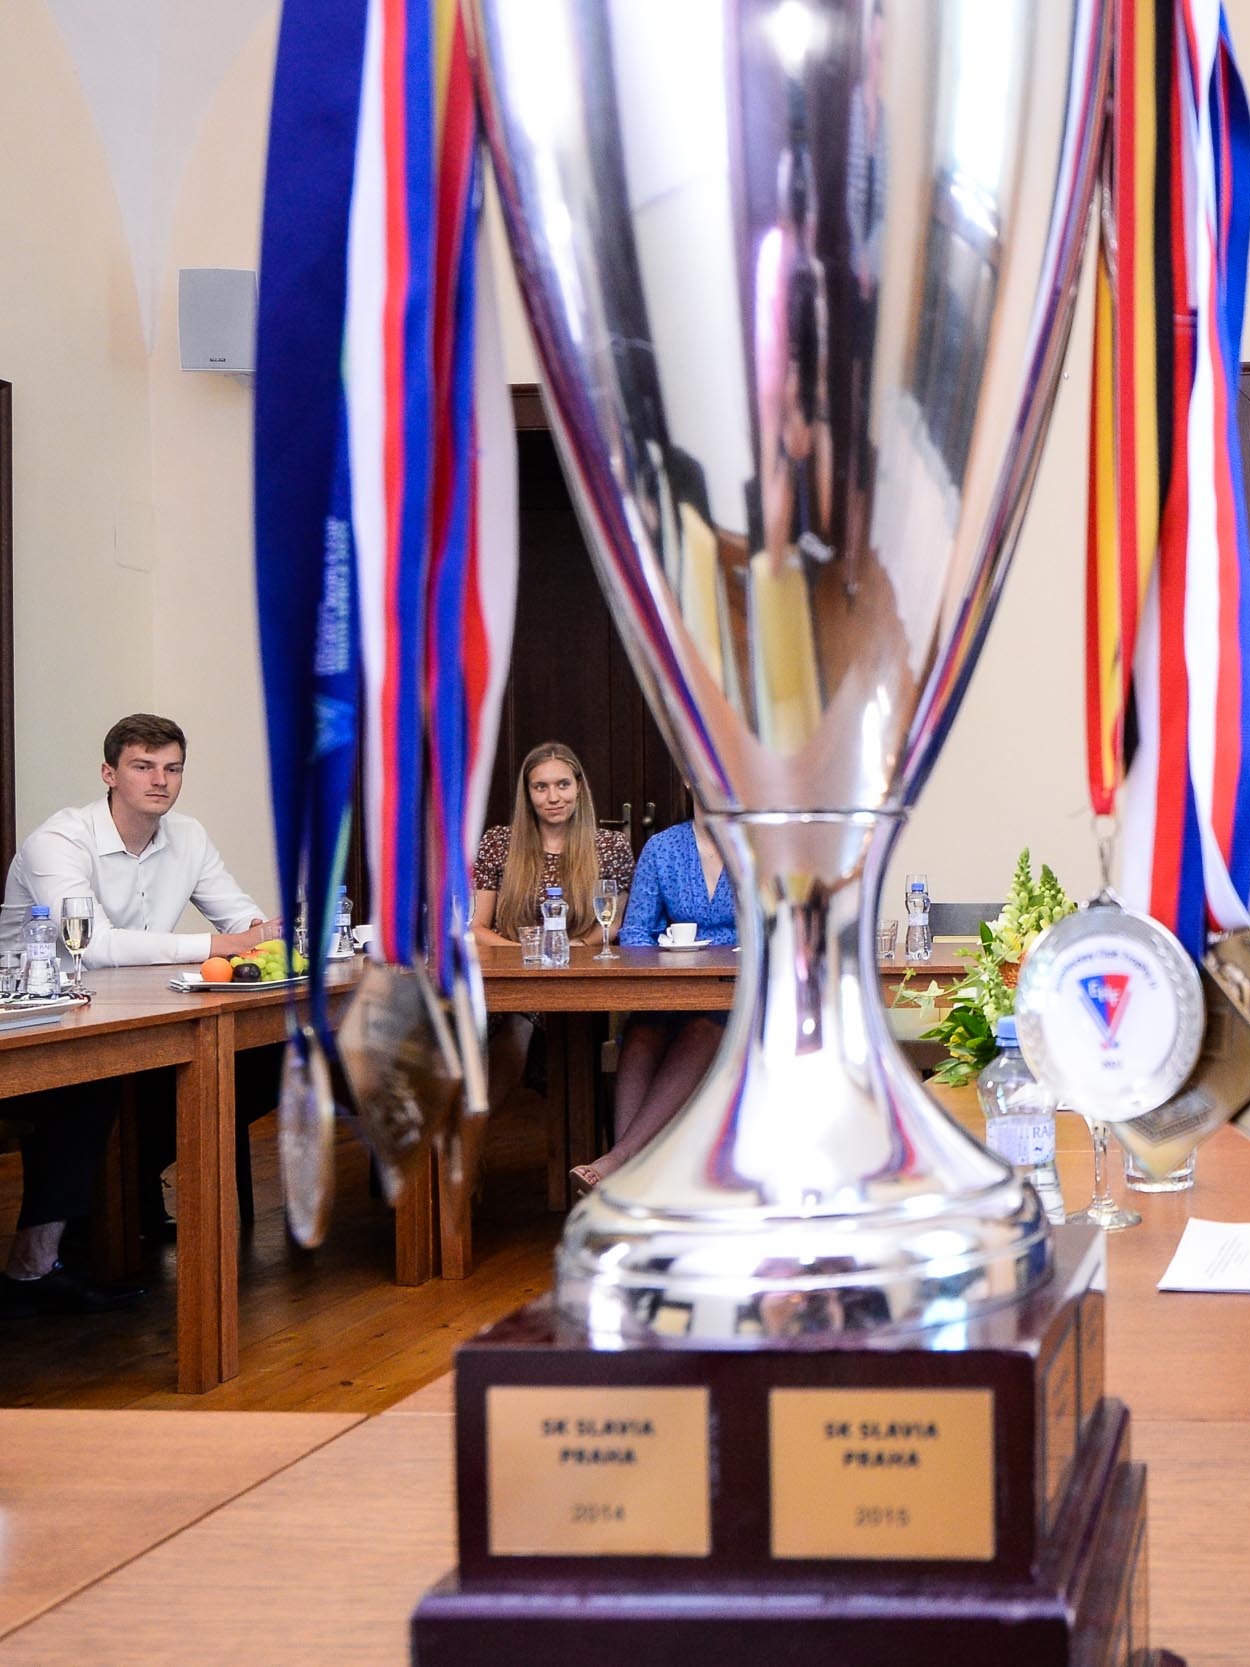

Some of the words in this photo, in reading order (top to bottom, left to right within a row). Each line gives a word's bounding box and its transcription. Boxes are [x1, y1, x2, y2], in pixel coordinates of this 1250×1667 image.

[542, 1418, 567, 1437] SK
[576, 1418, 655, 1437] SLAVIA
[824, 1420, 850, 1439] SK
[860, 1420, 938, 1439] SLAVIA
[559, 1447, 637, 1466] PRAHA
[842, 1449, 919, 1468] PRAHA
[571, 1503, 625, 1523] 2014
